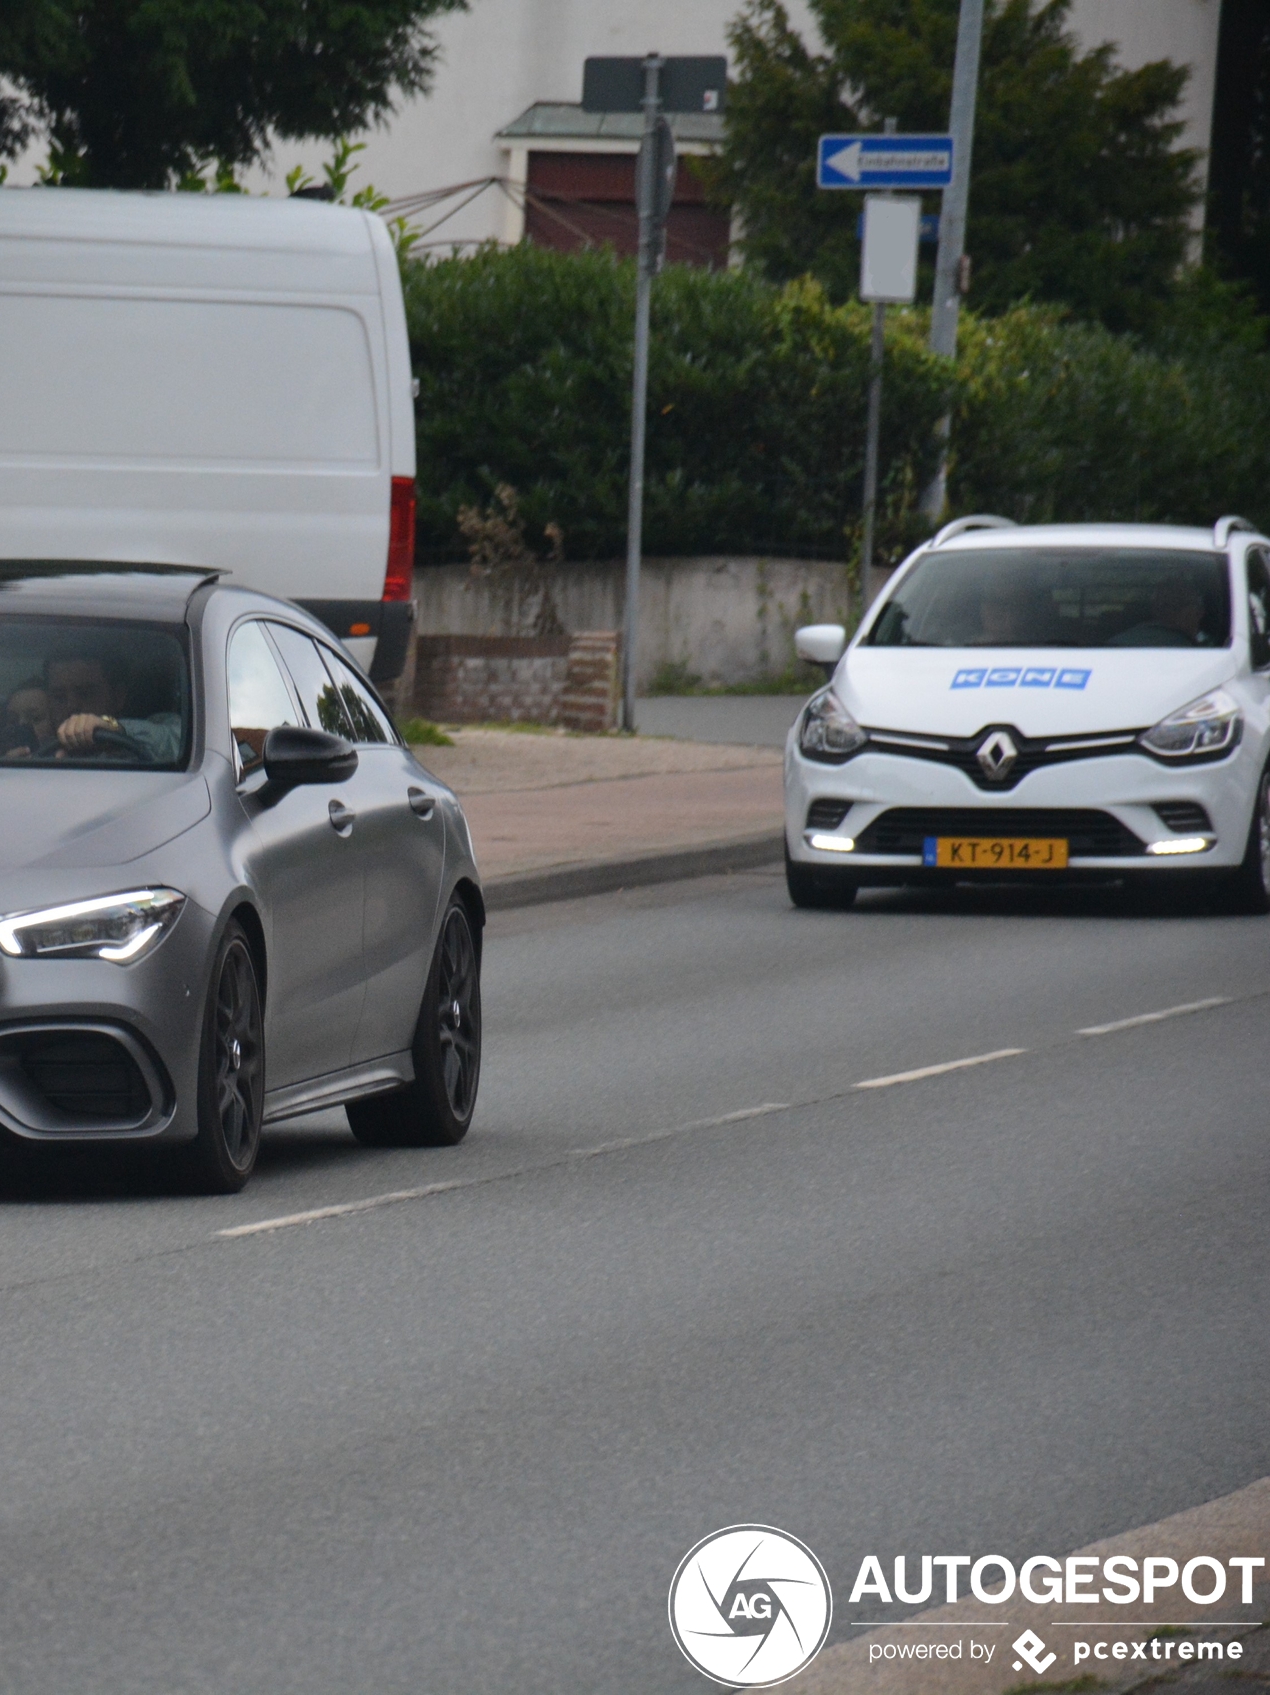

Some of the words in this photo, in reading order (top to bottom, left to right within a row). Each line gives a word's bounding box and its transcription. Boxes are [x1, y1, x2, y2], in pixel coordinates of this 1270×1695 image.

[856, 155, 946, 168] Einbahnstraße
[953, 669, 1087, 687] KONE
[950, 842, 1054, 863] KT-914-J
